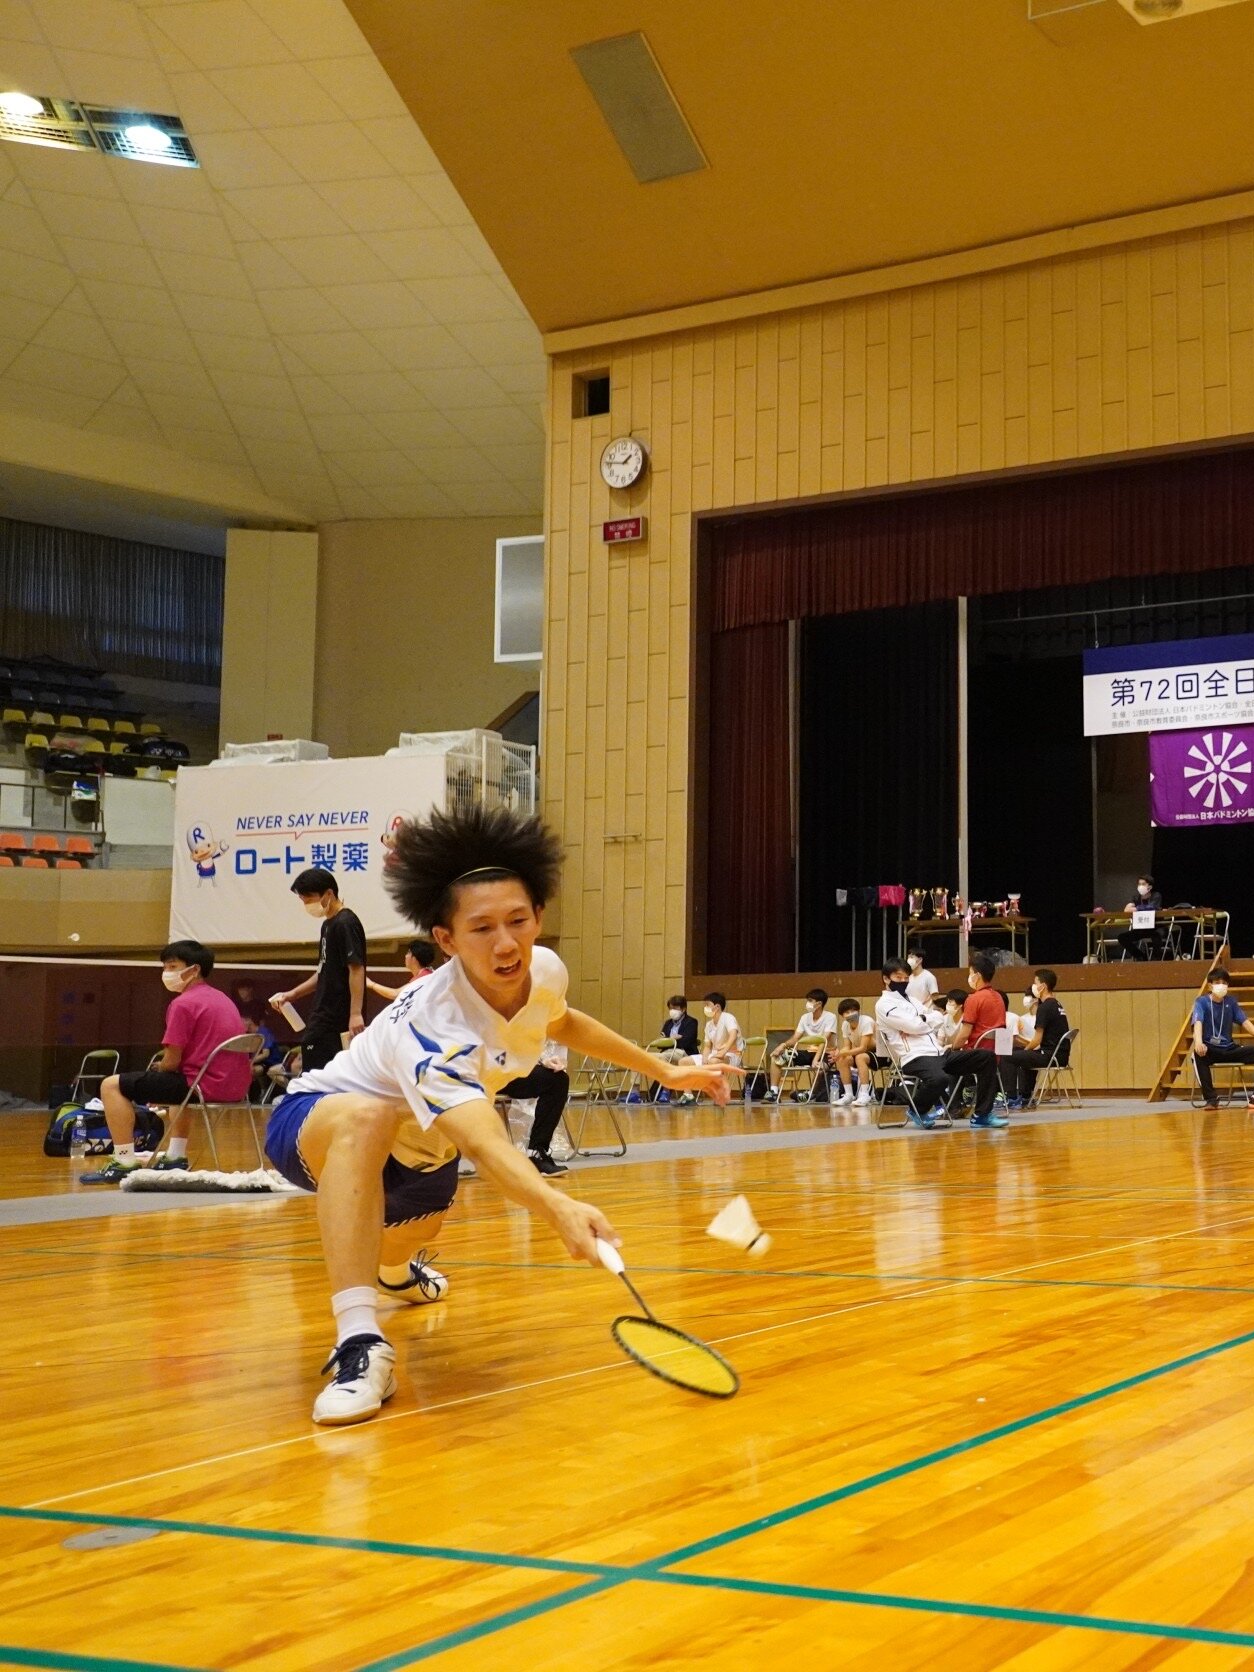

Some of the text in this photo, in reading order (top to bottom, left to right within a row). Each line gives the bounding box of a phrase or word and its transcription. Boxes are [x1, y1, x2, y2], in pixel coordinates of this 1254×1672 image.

[236, 810, 369, 831] NEVER SAY NEVER
[193, 827, 205, 844] R
[235, 841, 369, 875] ロート製薬
